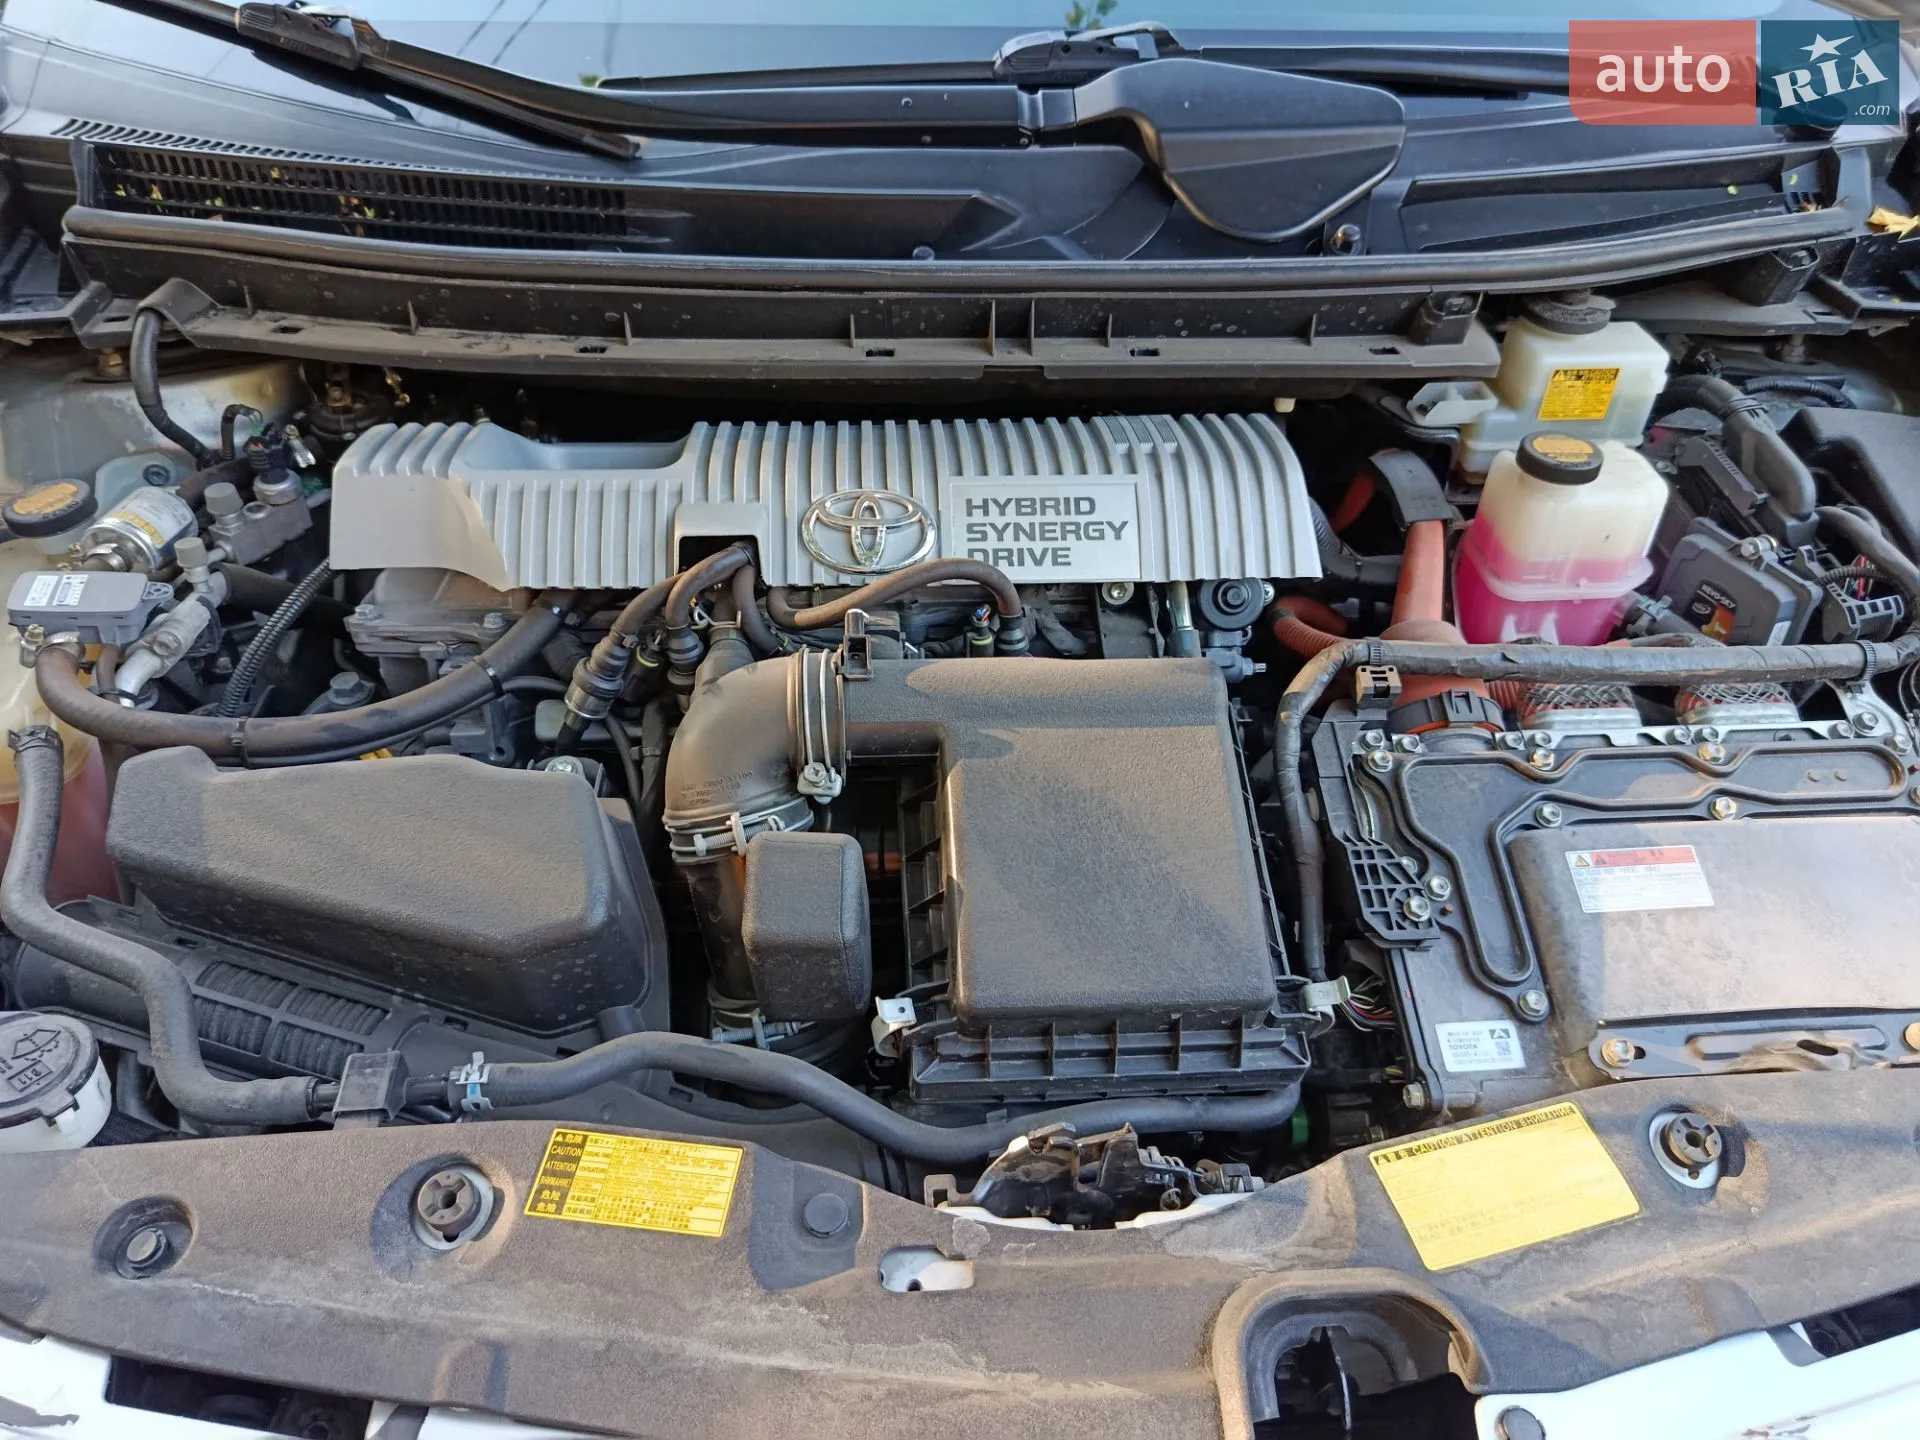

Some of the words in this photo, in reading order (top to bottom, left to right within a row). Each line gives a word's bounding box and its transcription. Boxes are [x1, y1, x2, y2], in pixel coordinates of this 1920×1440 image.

[966, 496, 1096, 517] HYBRID
[966, 520, 1129, 542] SYNERGY
[967, 546, 1072, 567] DRIVE
[1411, 1136, 1458, 1156] CAUTION
[1461, 1120, 1517, 1142] ATTENTION
[550, 1145, 583, 1157] CAUTION
[545, 1161, 577, 1172] ATTENTION
